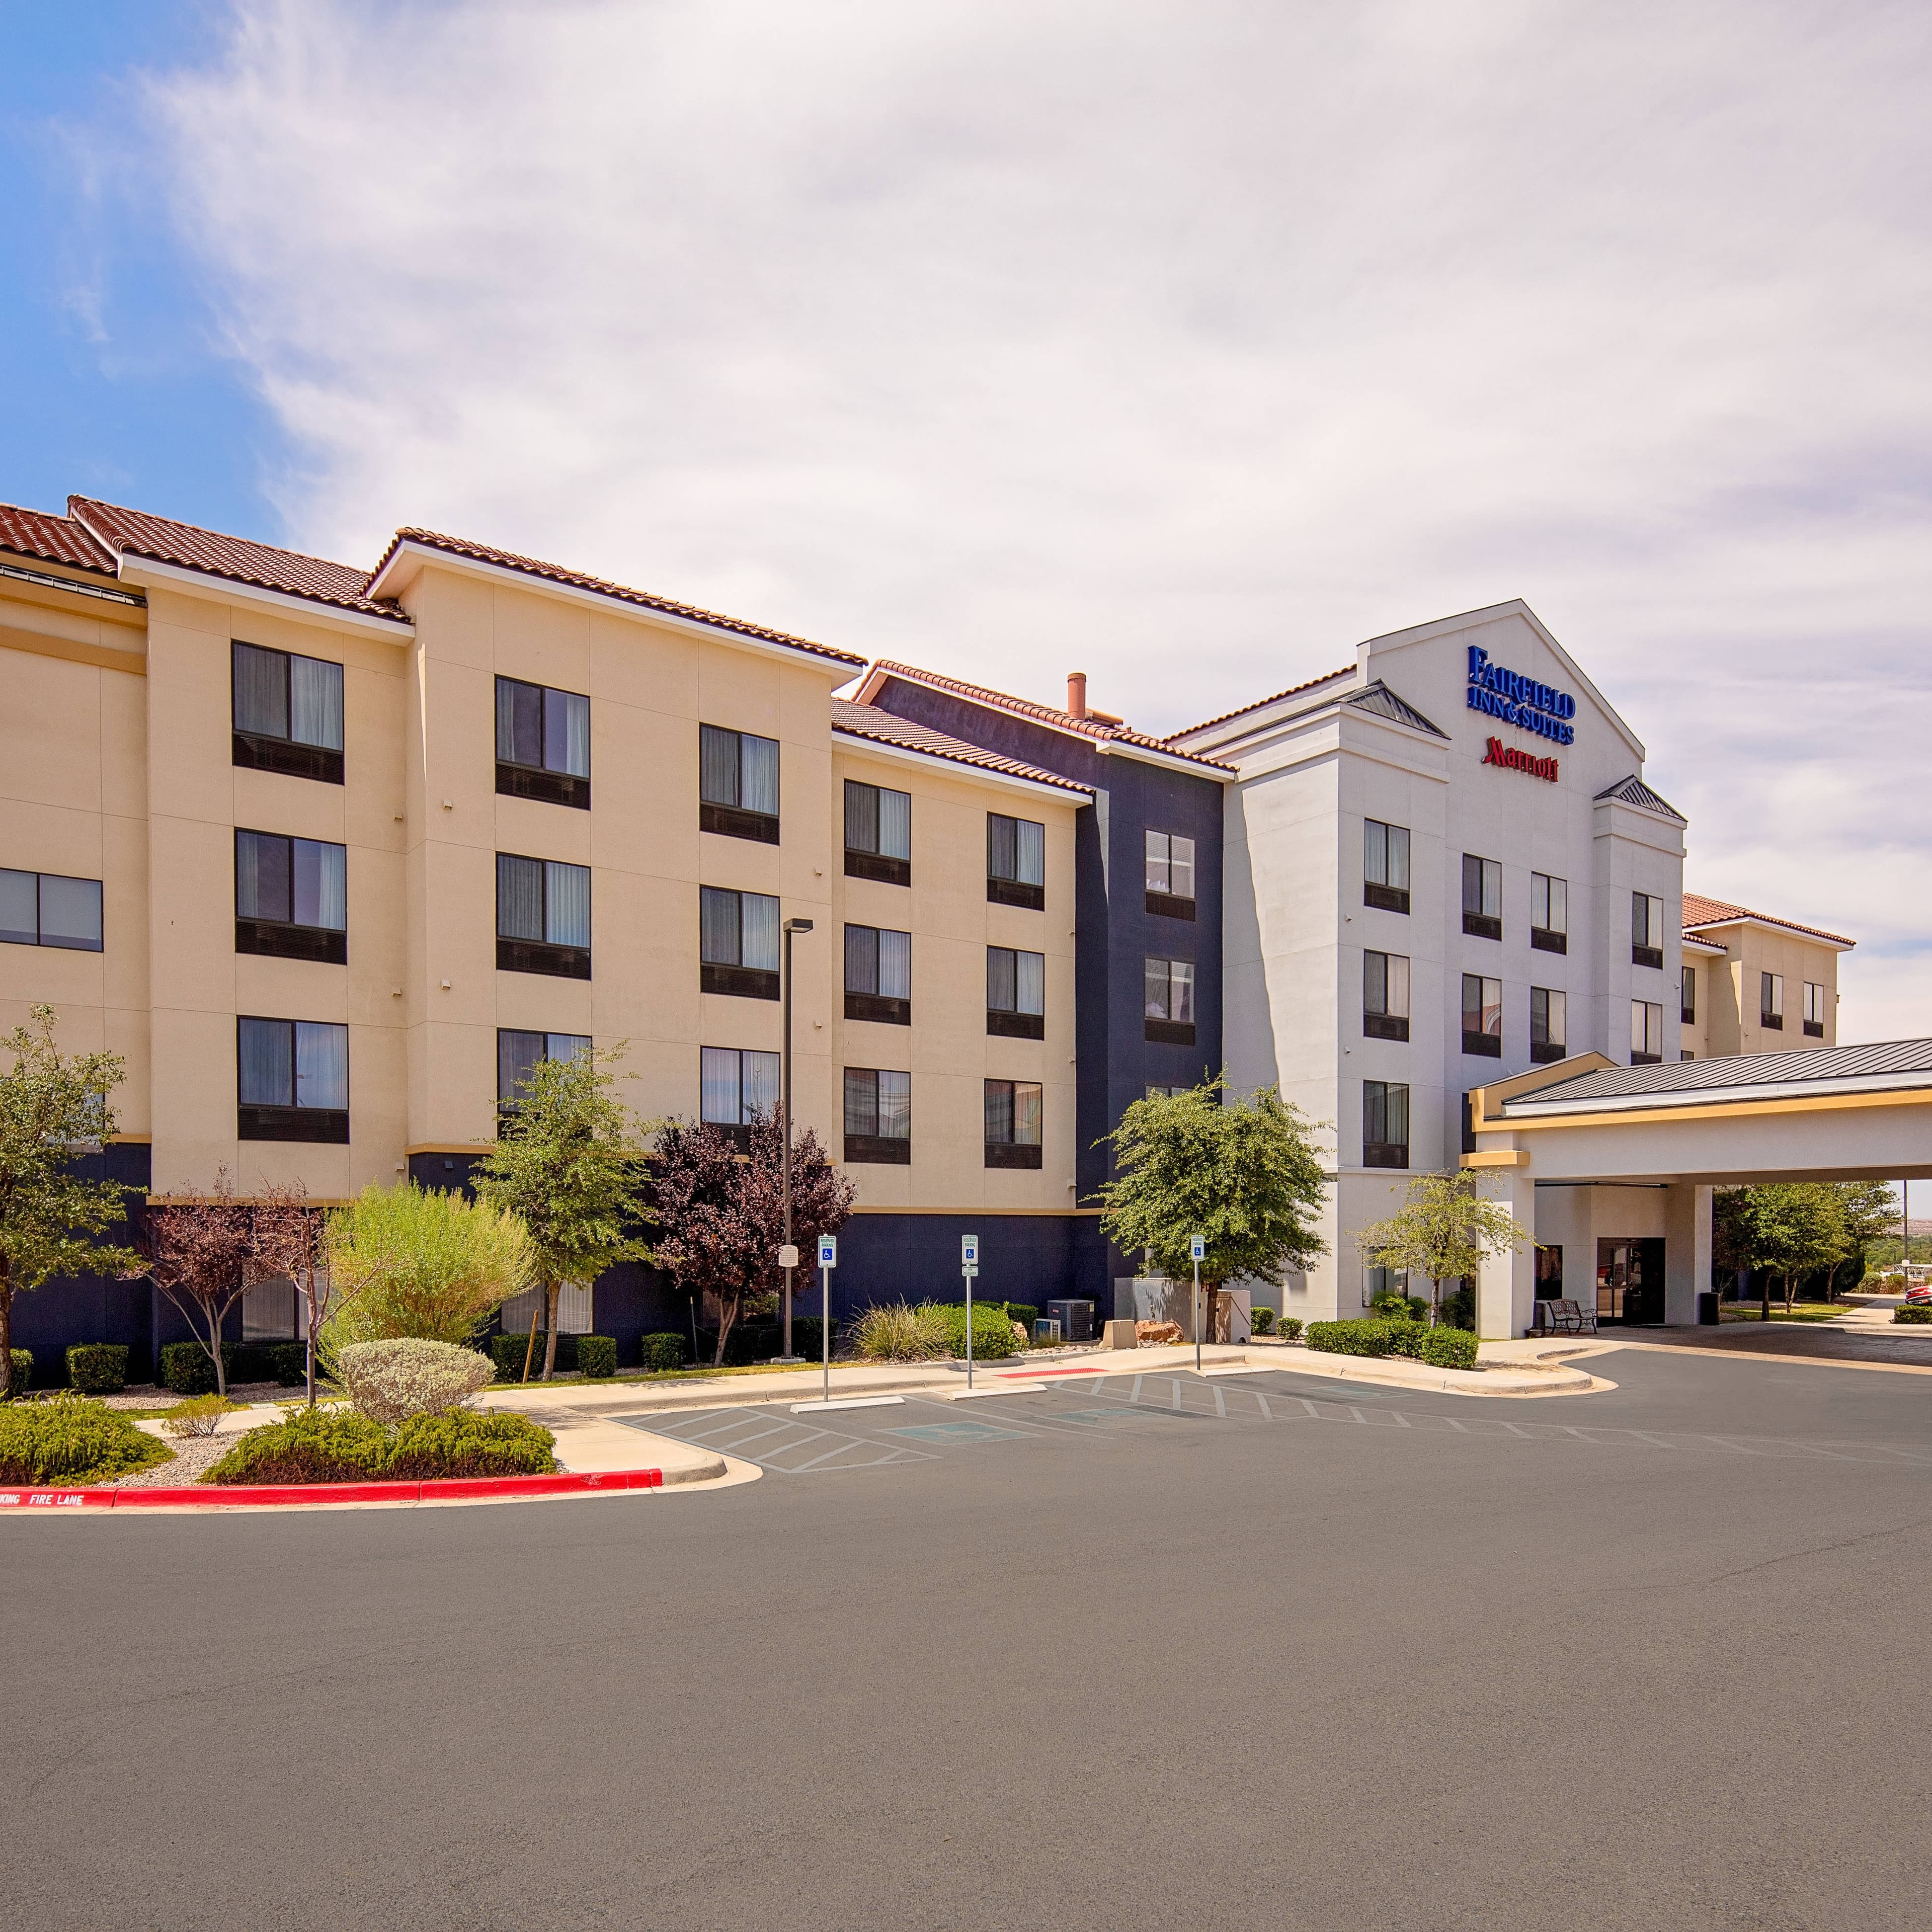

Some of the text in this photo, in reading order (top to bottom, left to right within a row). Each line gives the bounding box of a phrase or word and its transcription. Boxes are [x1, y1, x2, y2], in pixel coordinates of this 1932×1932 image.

[1468, 646, 1575, 720] FAIRFIELD
[1481, 736, 1559, 782] Marriott
[0, 1494, 84, 1506] KING FIRE LANE
